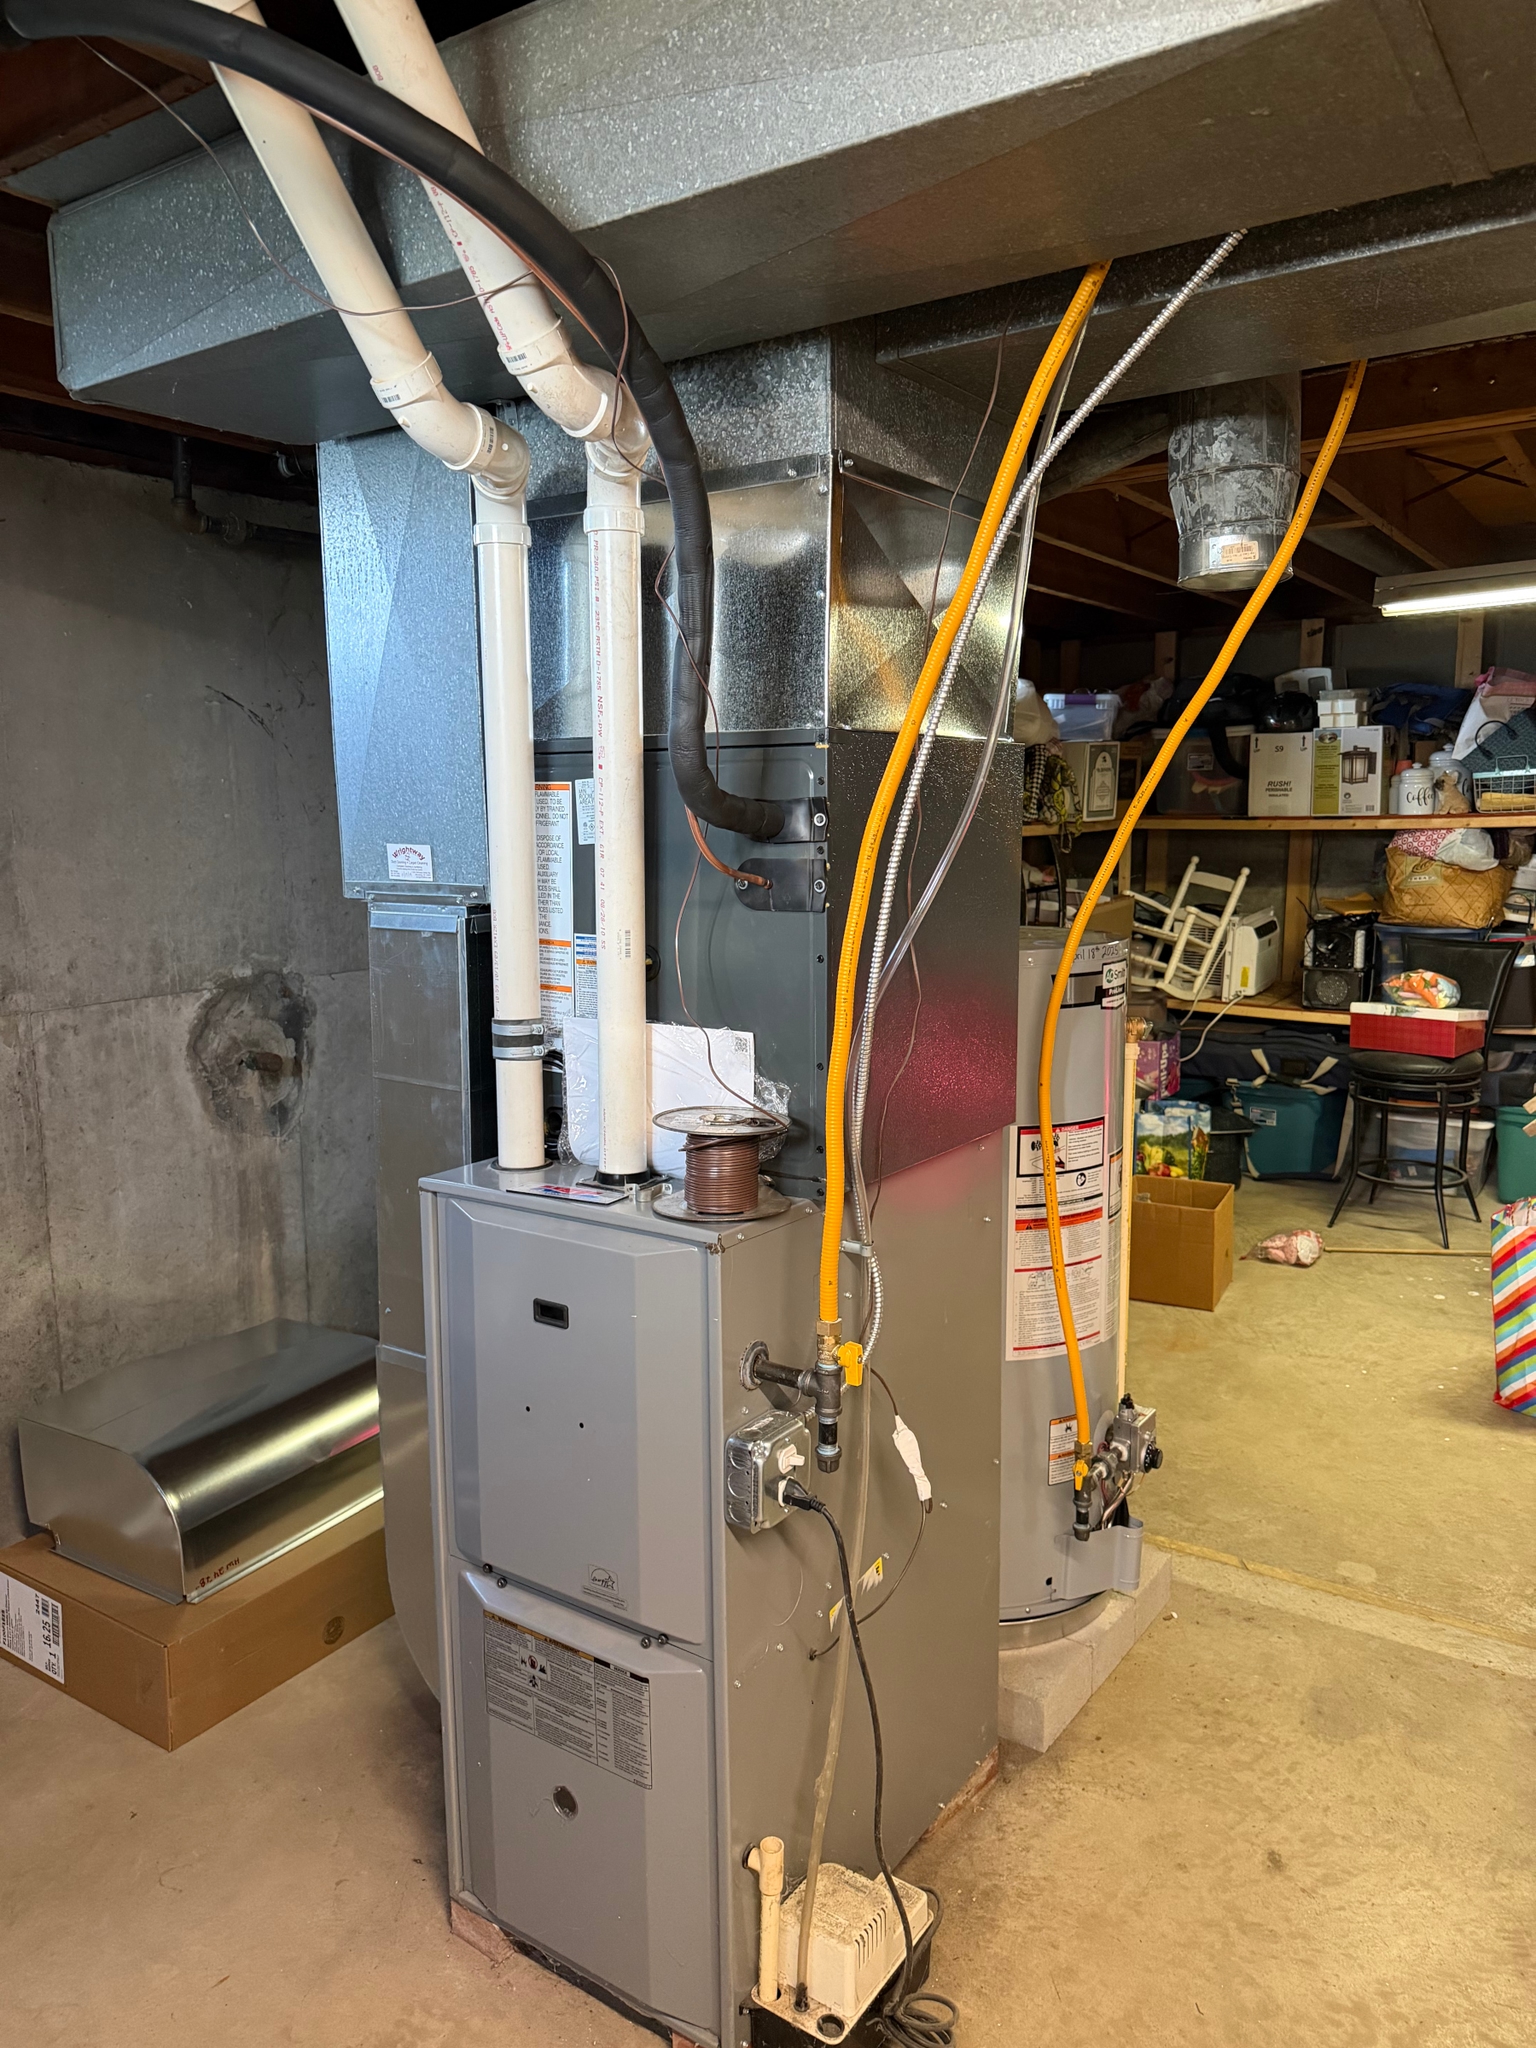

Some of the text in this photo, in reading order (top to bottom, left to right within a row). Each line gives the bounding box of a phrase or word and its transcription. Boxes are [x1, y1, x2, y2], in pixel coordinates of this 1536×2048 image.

[392, 846, 425, 861] Wrightway
[1102, 946, 1119, 958] 2025
[1160, 1042, 1168, 1097] Pull-Ups
[42, 1620, 52, 1648] 16.25
